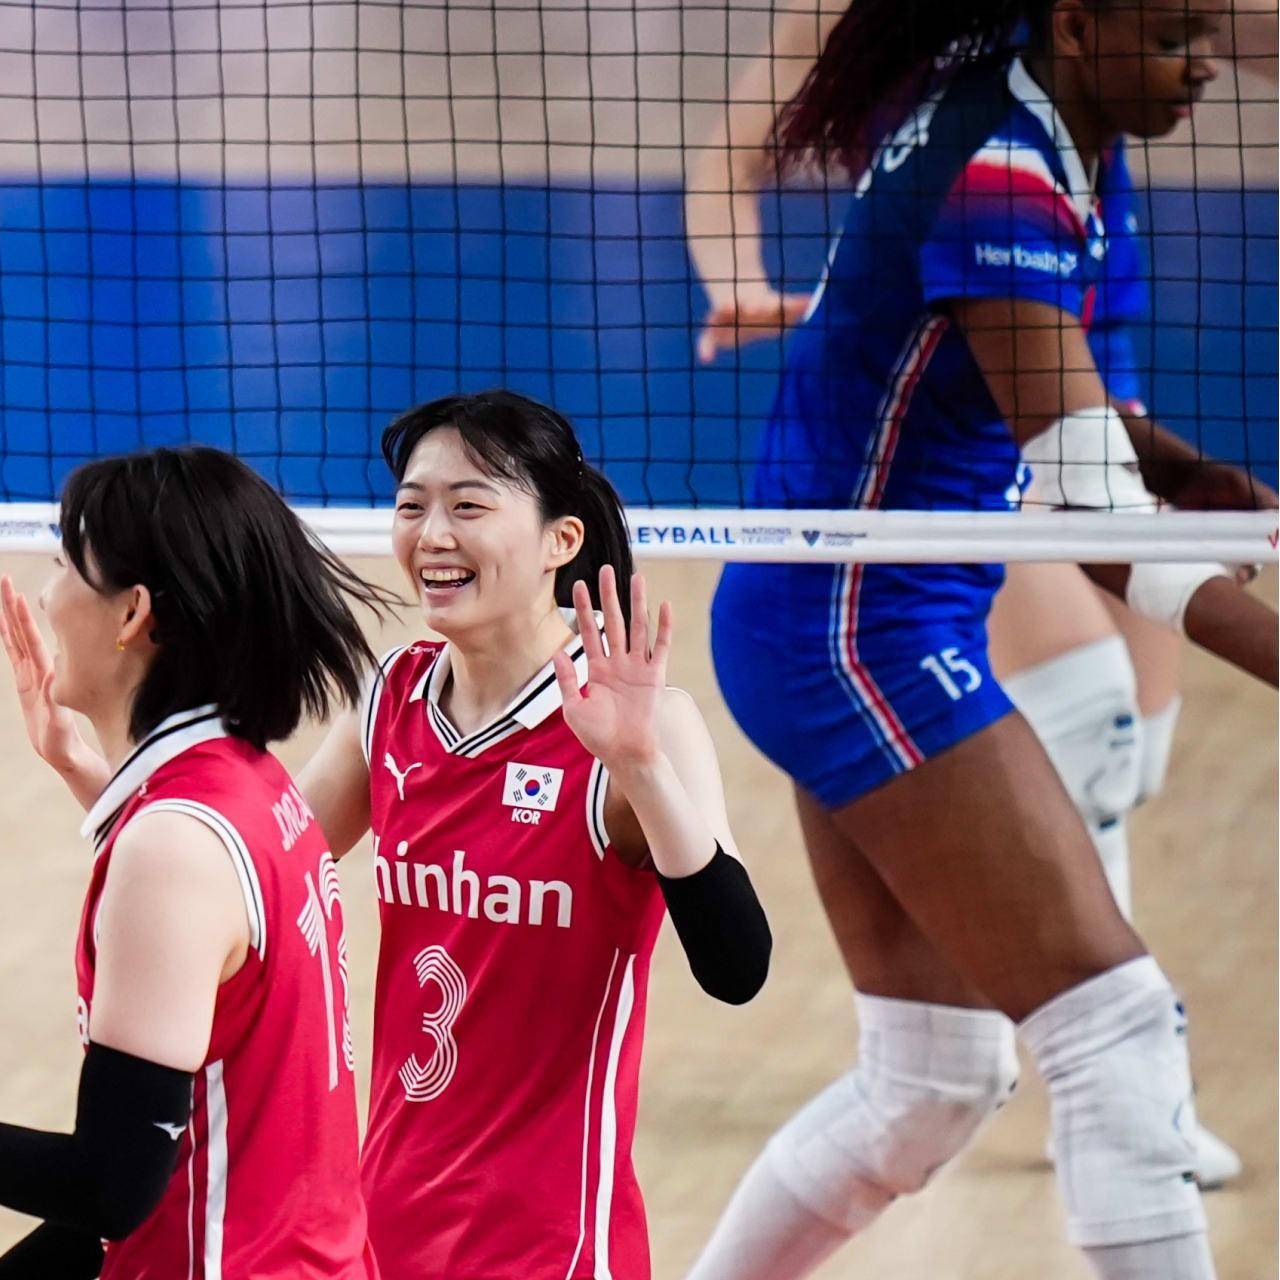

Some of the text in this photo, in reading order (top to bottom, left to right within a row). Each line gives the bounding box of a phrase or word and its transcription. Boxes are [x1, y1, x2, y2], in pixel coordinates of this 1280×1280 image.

[920, 647, 982, 701] 15
[511, 807, 542, 825] KOR
[398, 944, 468, 1103] 3
